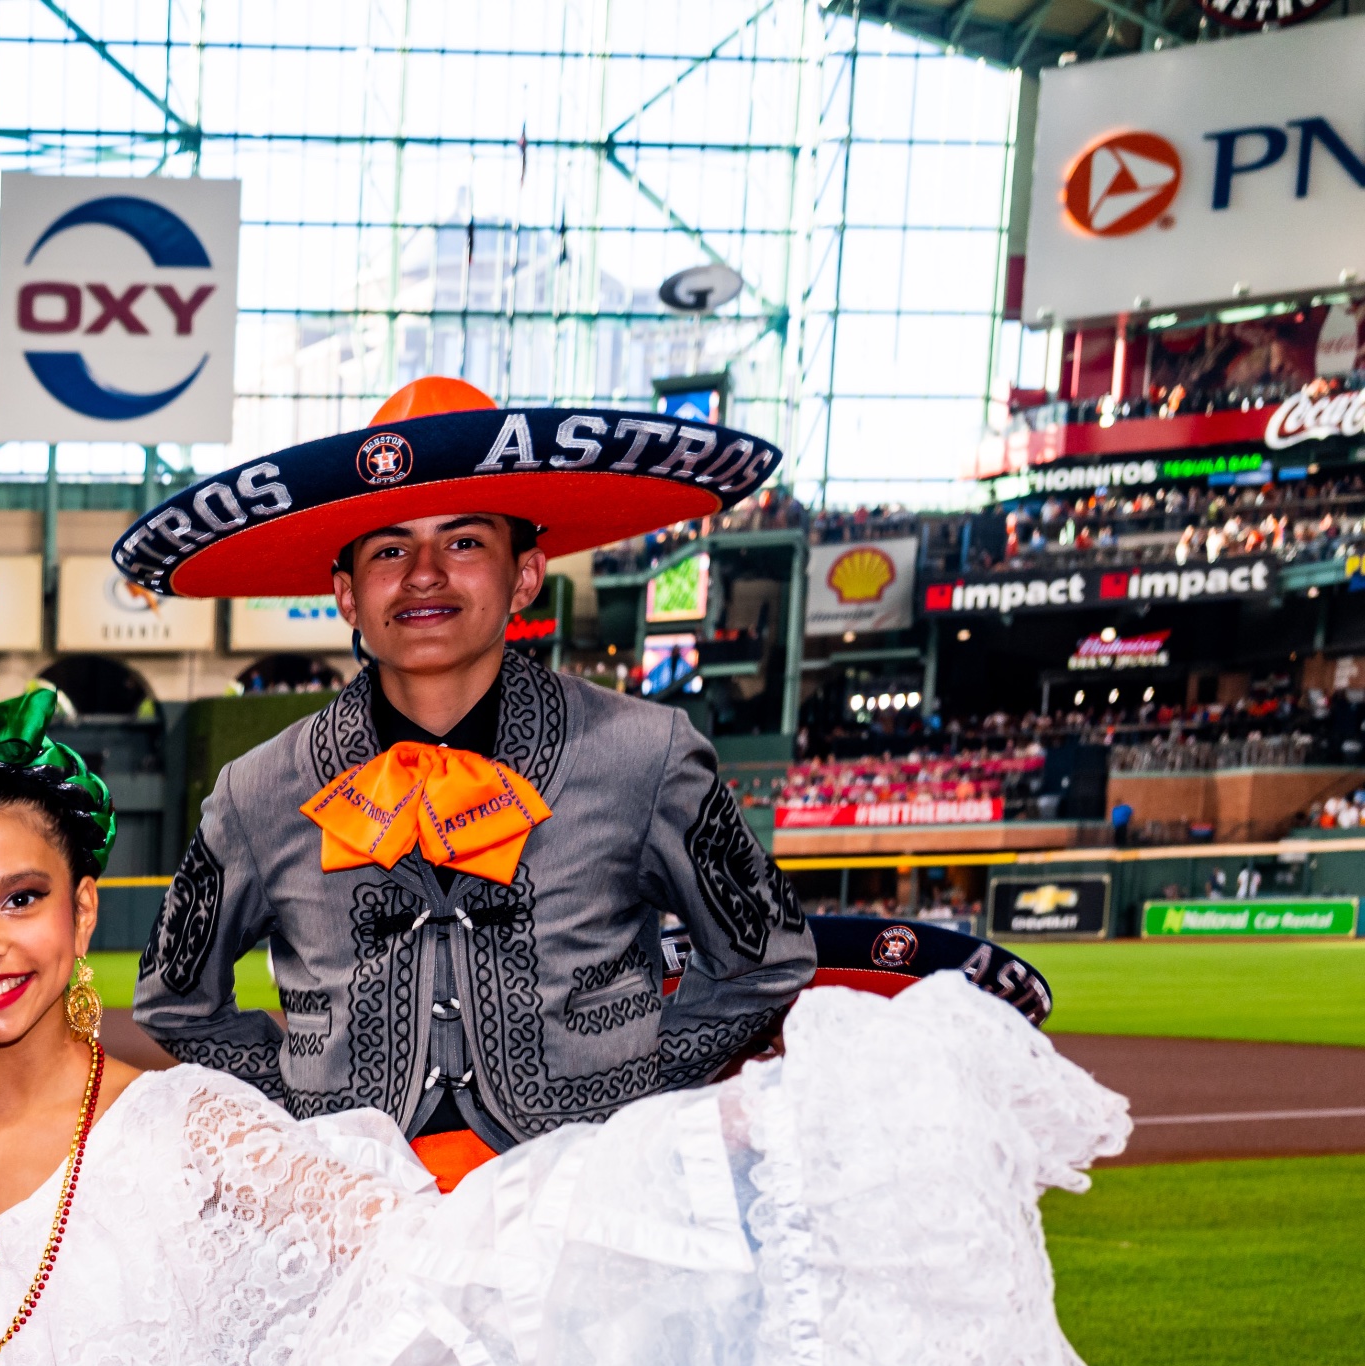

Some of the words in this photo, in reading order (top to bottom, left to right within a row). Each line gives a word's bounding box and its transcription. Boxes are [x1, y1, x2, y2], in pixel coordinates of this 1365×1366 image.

[17, 281, 216, 337] OXY
[362, 436, 404, 454] HOUSTON
[474, 413, 773, 492] ASTROS
[369, 471, 406, 483] ASTROS
[1036, 461, 1157, 492] HORNITOS
[114, 461, 293, 594] TROS
[952, 573, 1086, 612] impact
[1127, 560, 1269, 601] impact
[341, 786, 394, 825] ASTROS
[445, 792, 514, 834] ASTROS
